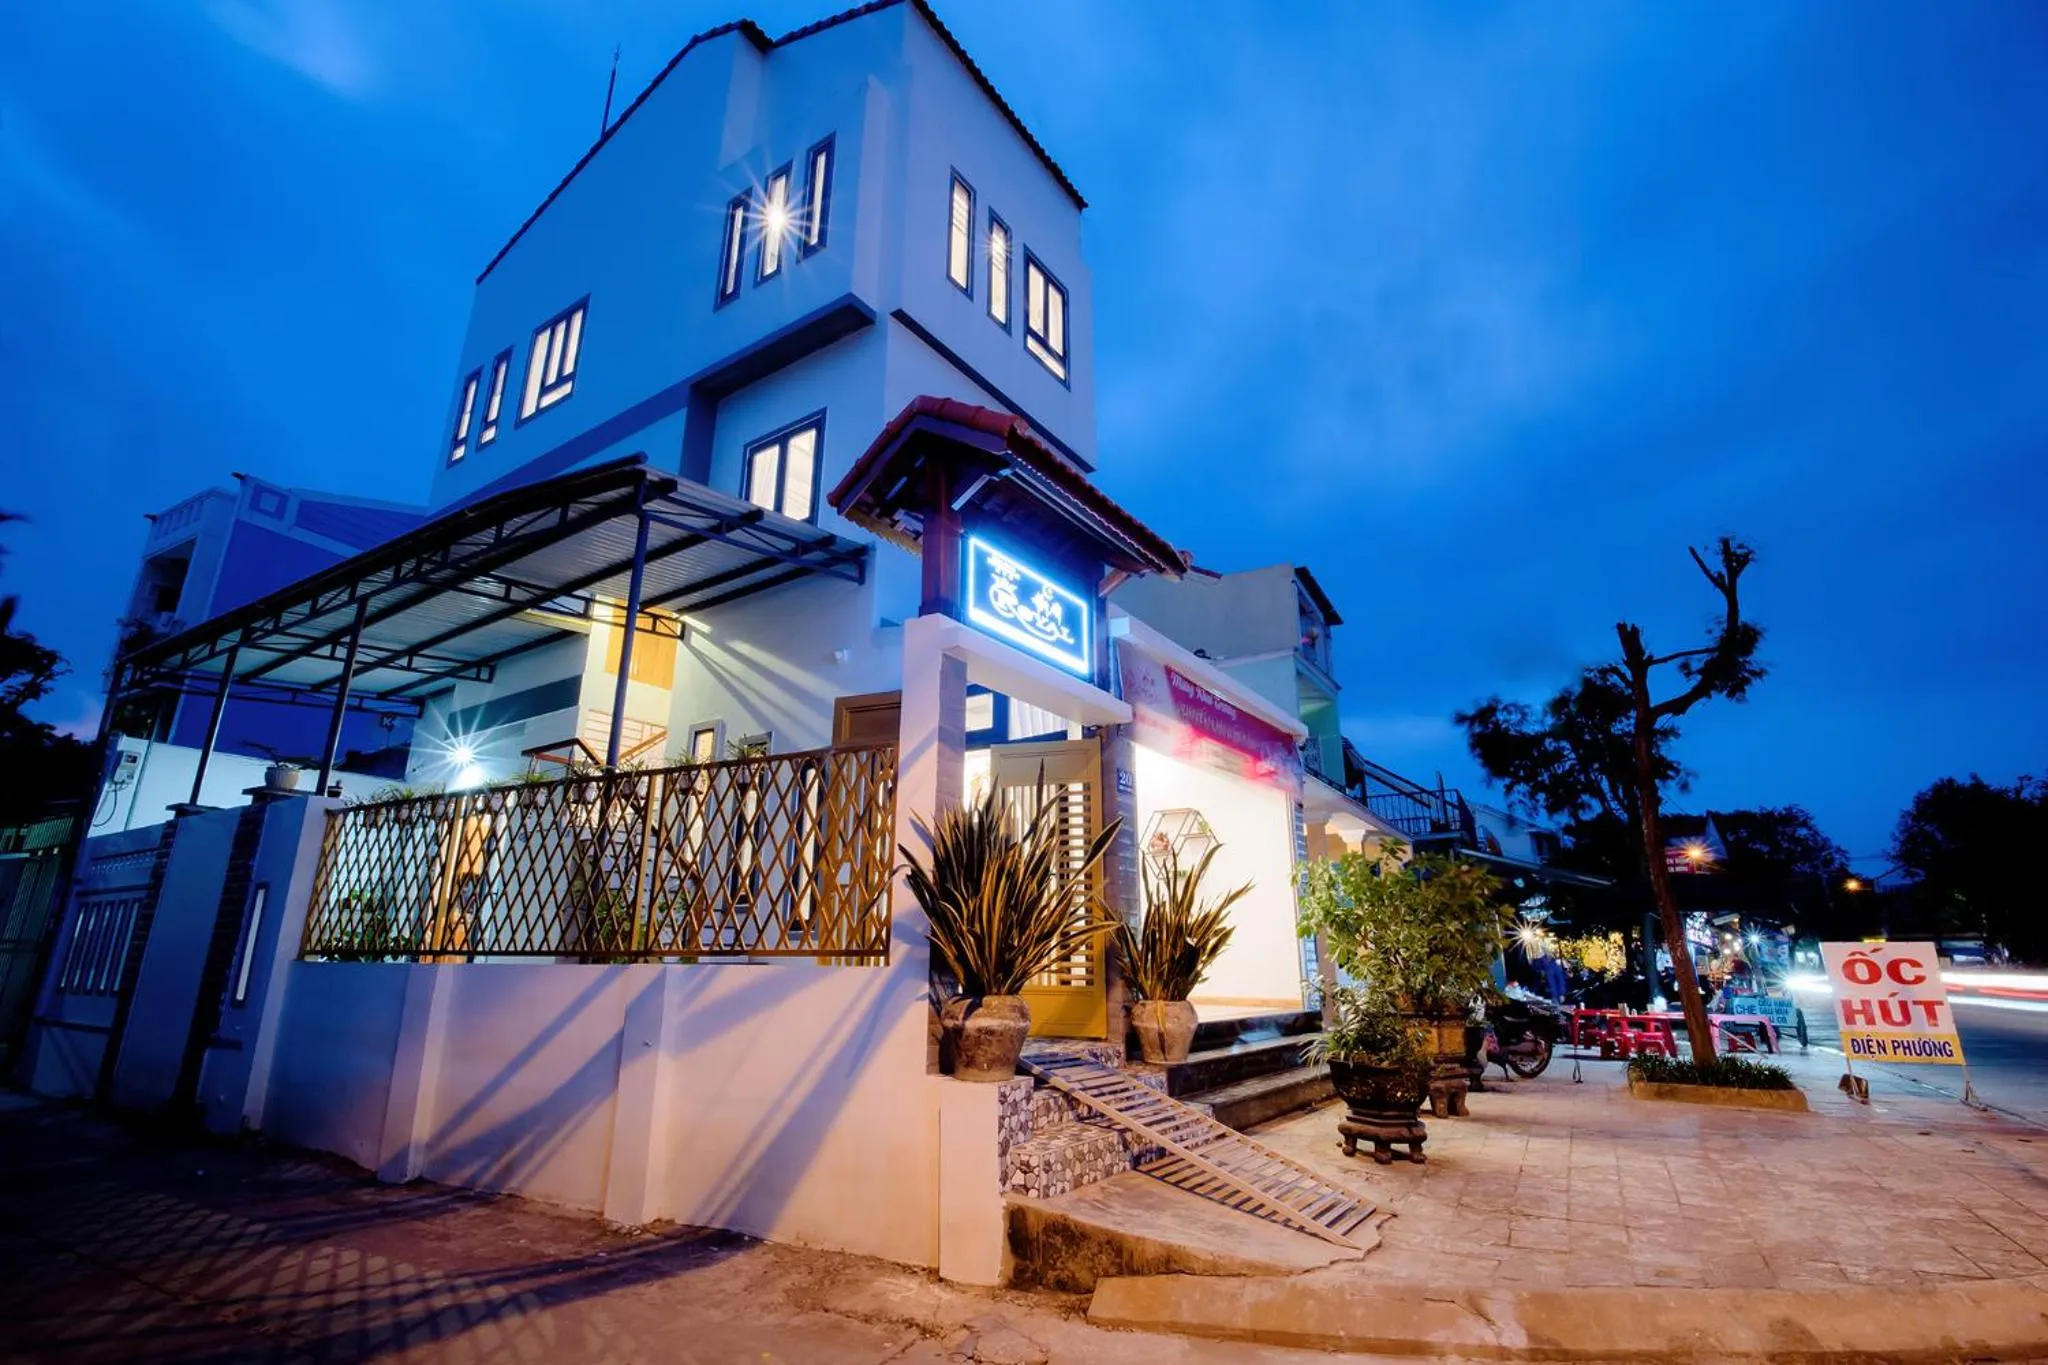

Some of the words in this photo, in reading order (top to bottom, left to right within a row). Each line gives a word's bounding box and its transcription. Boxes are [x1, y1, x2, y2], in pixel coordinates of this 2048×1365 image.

[1842, 947, 1927, 985] ỐC
[1840, 991, 1945, 1027] HÚT
[1851, 1034, 1888, 1058] ĐIỆN
[1891, 1037, 1955, 1058] PHƯƠNG
